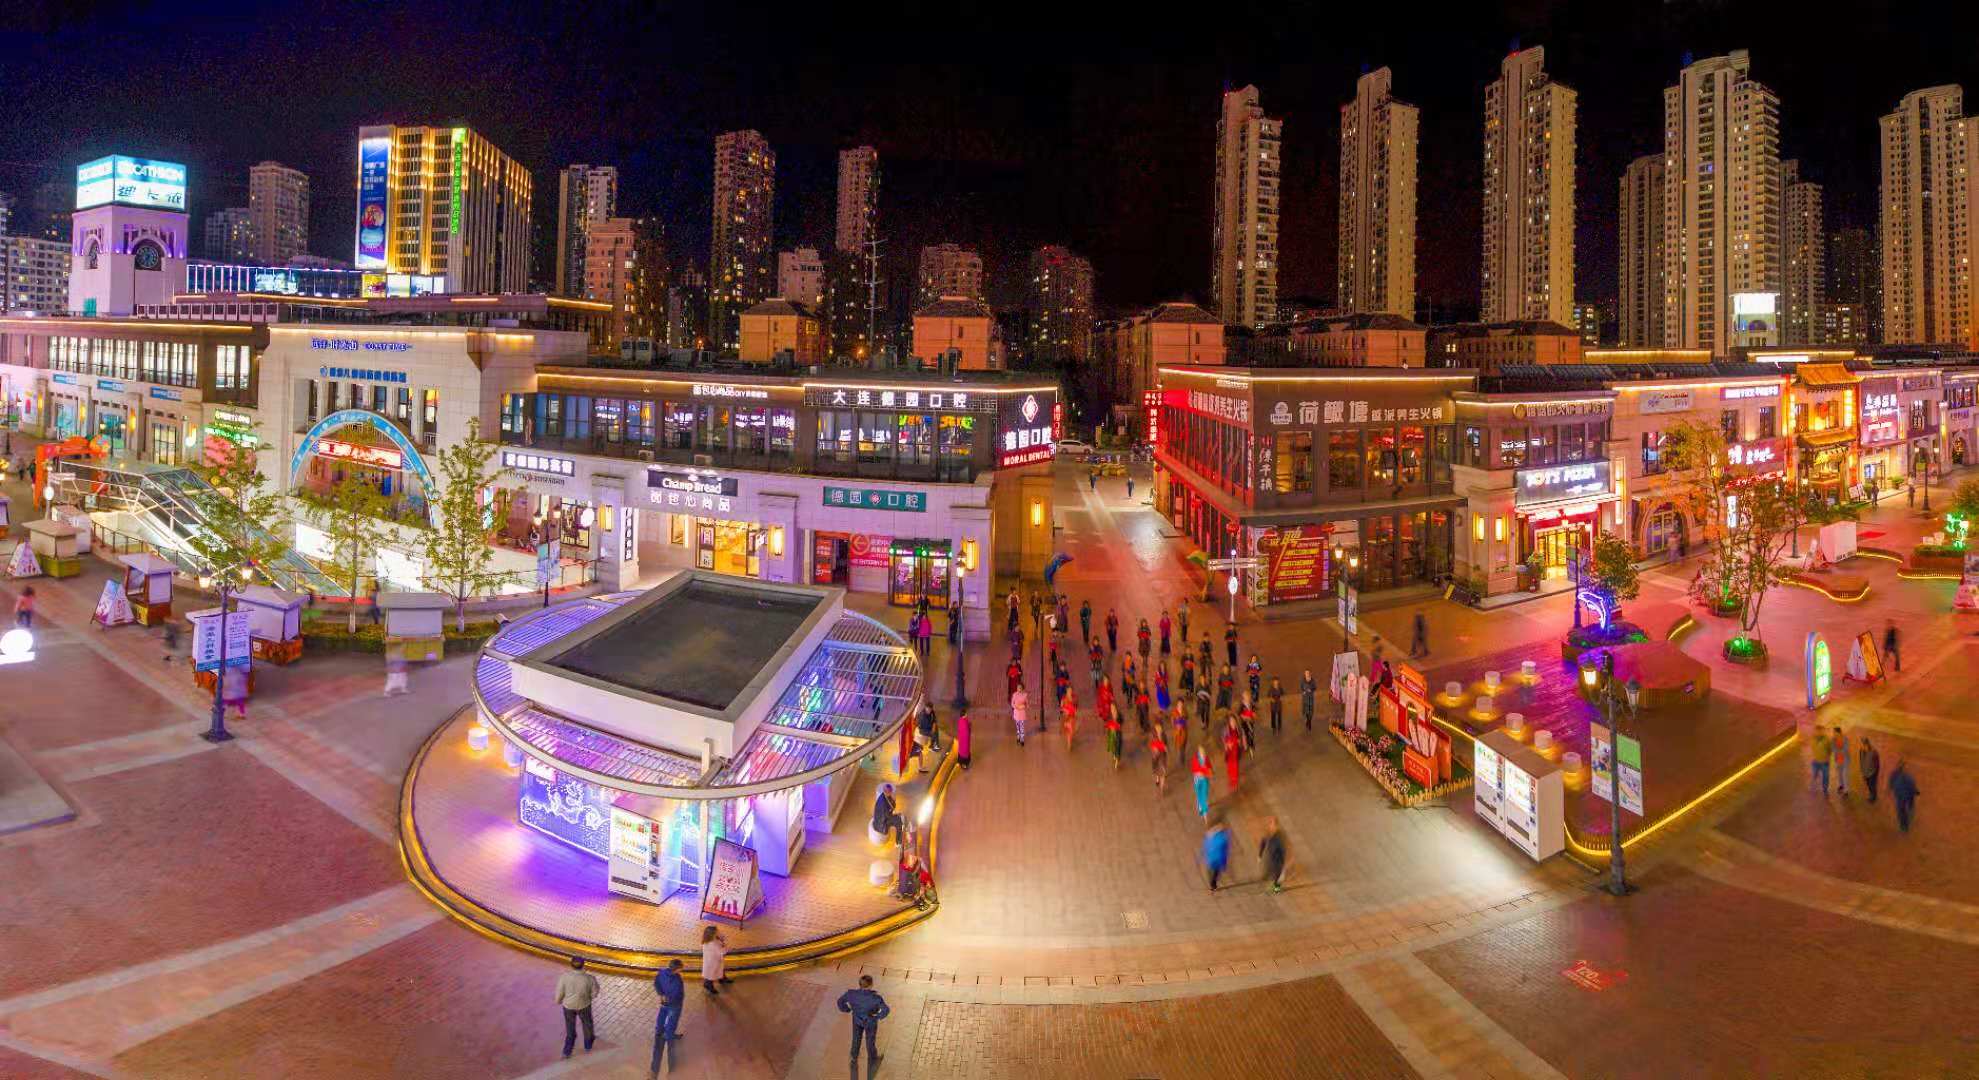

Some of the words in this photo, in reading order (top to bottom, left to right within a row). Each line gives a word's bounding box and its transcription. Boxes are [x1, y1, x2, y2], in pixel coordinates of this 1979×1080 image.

[833, 390, 966, 409] 大连德园口腔
[662, 478, 694, 492] Champ
[694, 482, 722, 494] Bread
